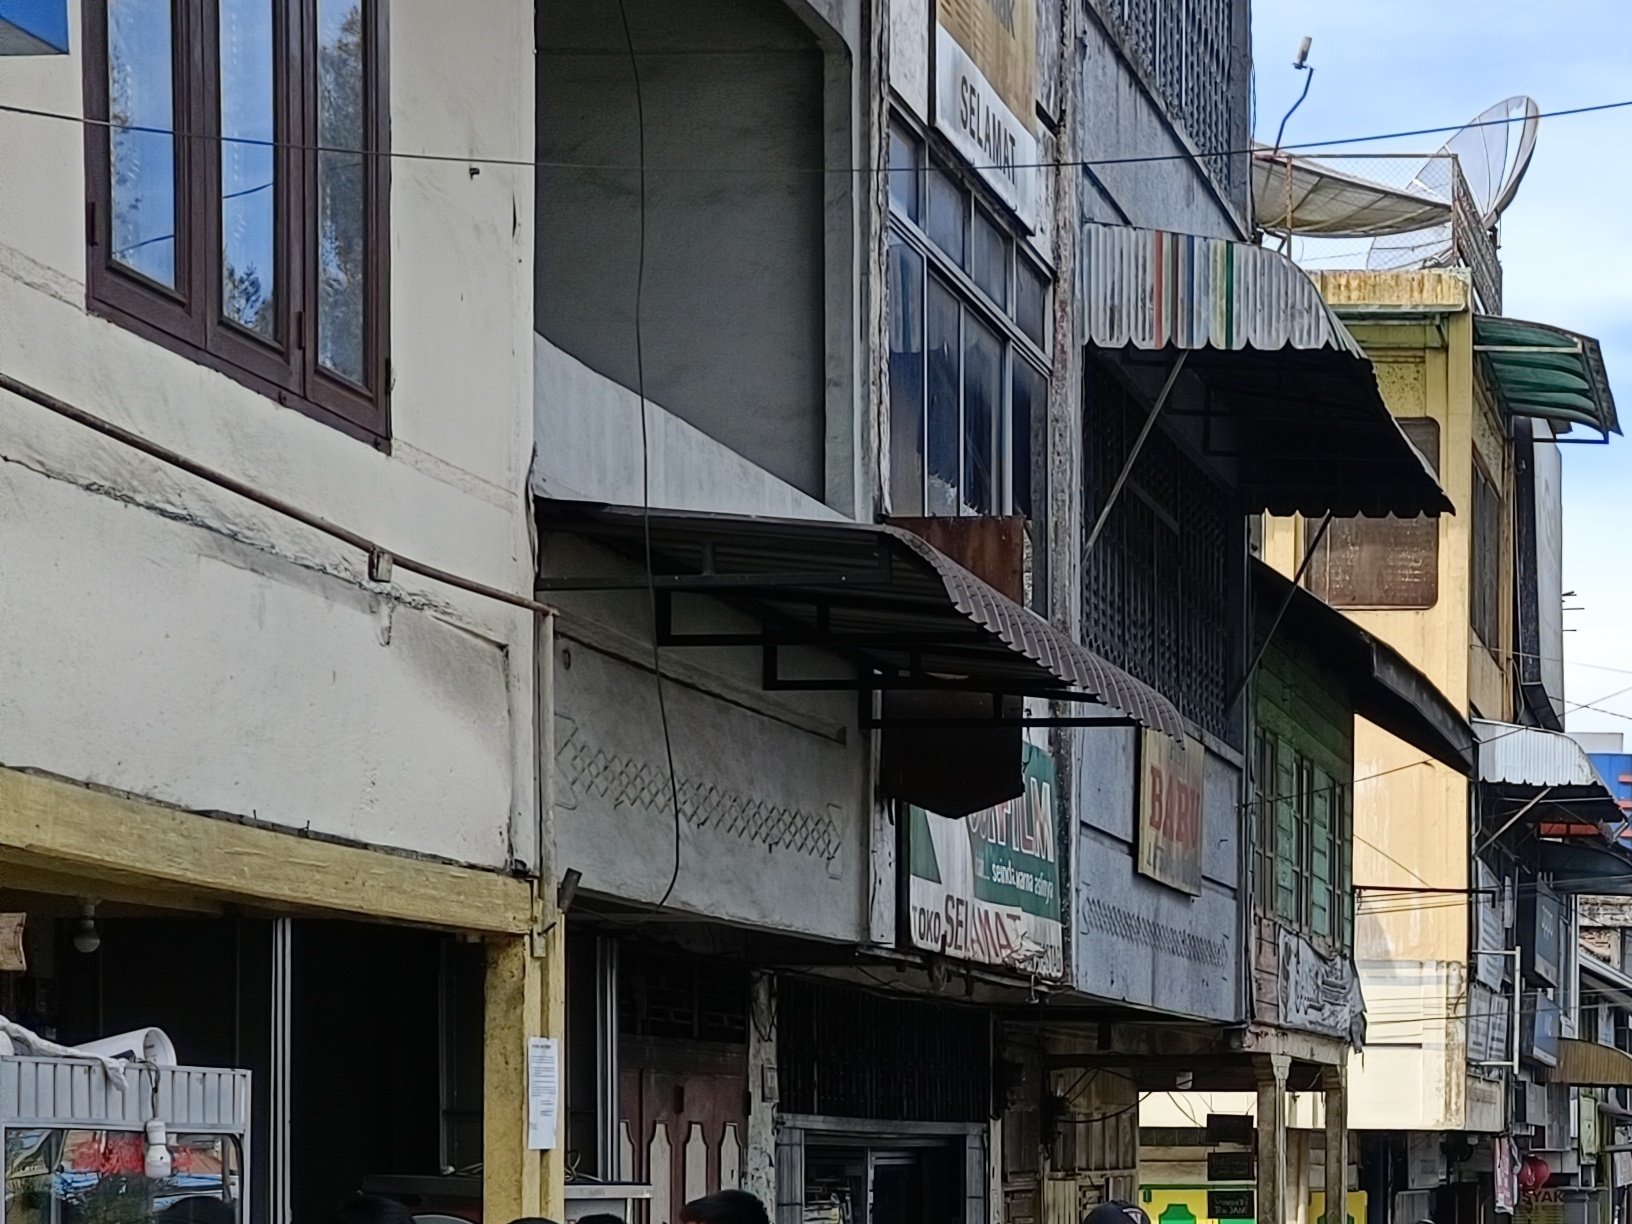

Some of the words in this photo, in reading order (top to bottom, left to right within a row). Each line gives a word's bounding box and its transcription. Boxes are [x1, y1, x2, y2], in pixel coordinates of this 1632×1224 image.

[960, 74, 1016, 185] SELAMAT
[1149, 764, 1200, 850] BARU
[912, 905, 941, 944] TOKO
[944, 894, 1021, 964] SELAMAT
